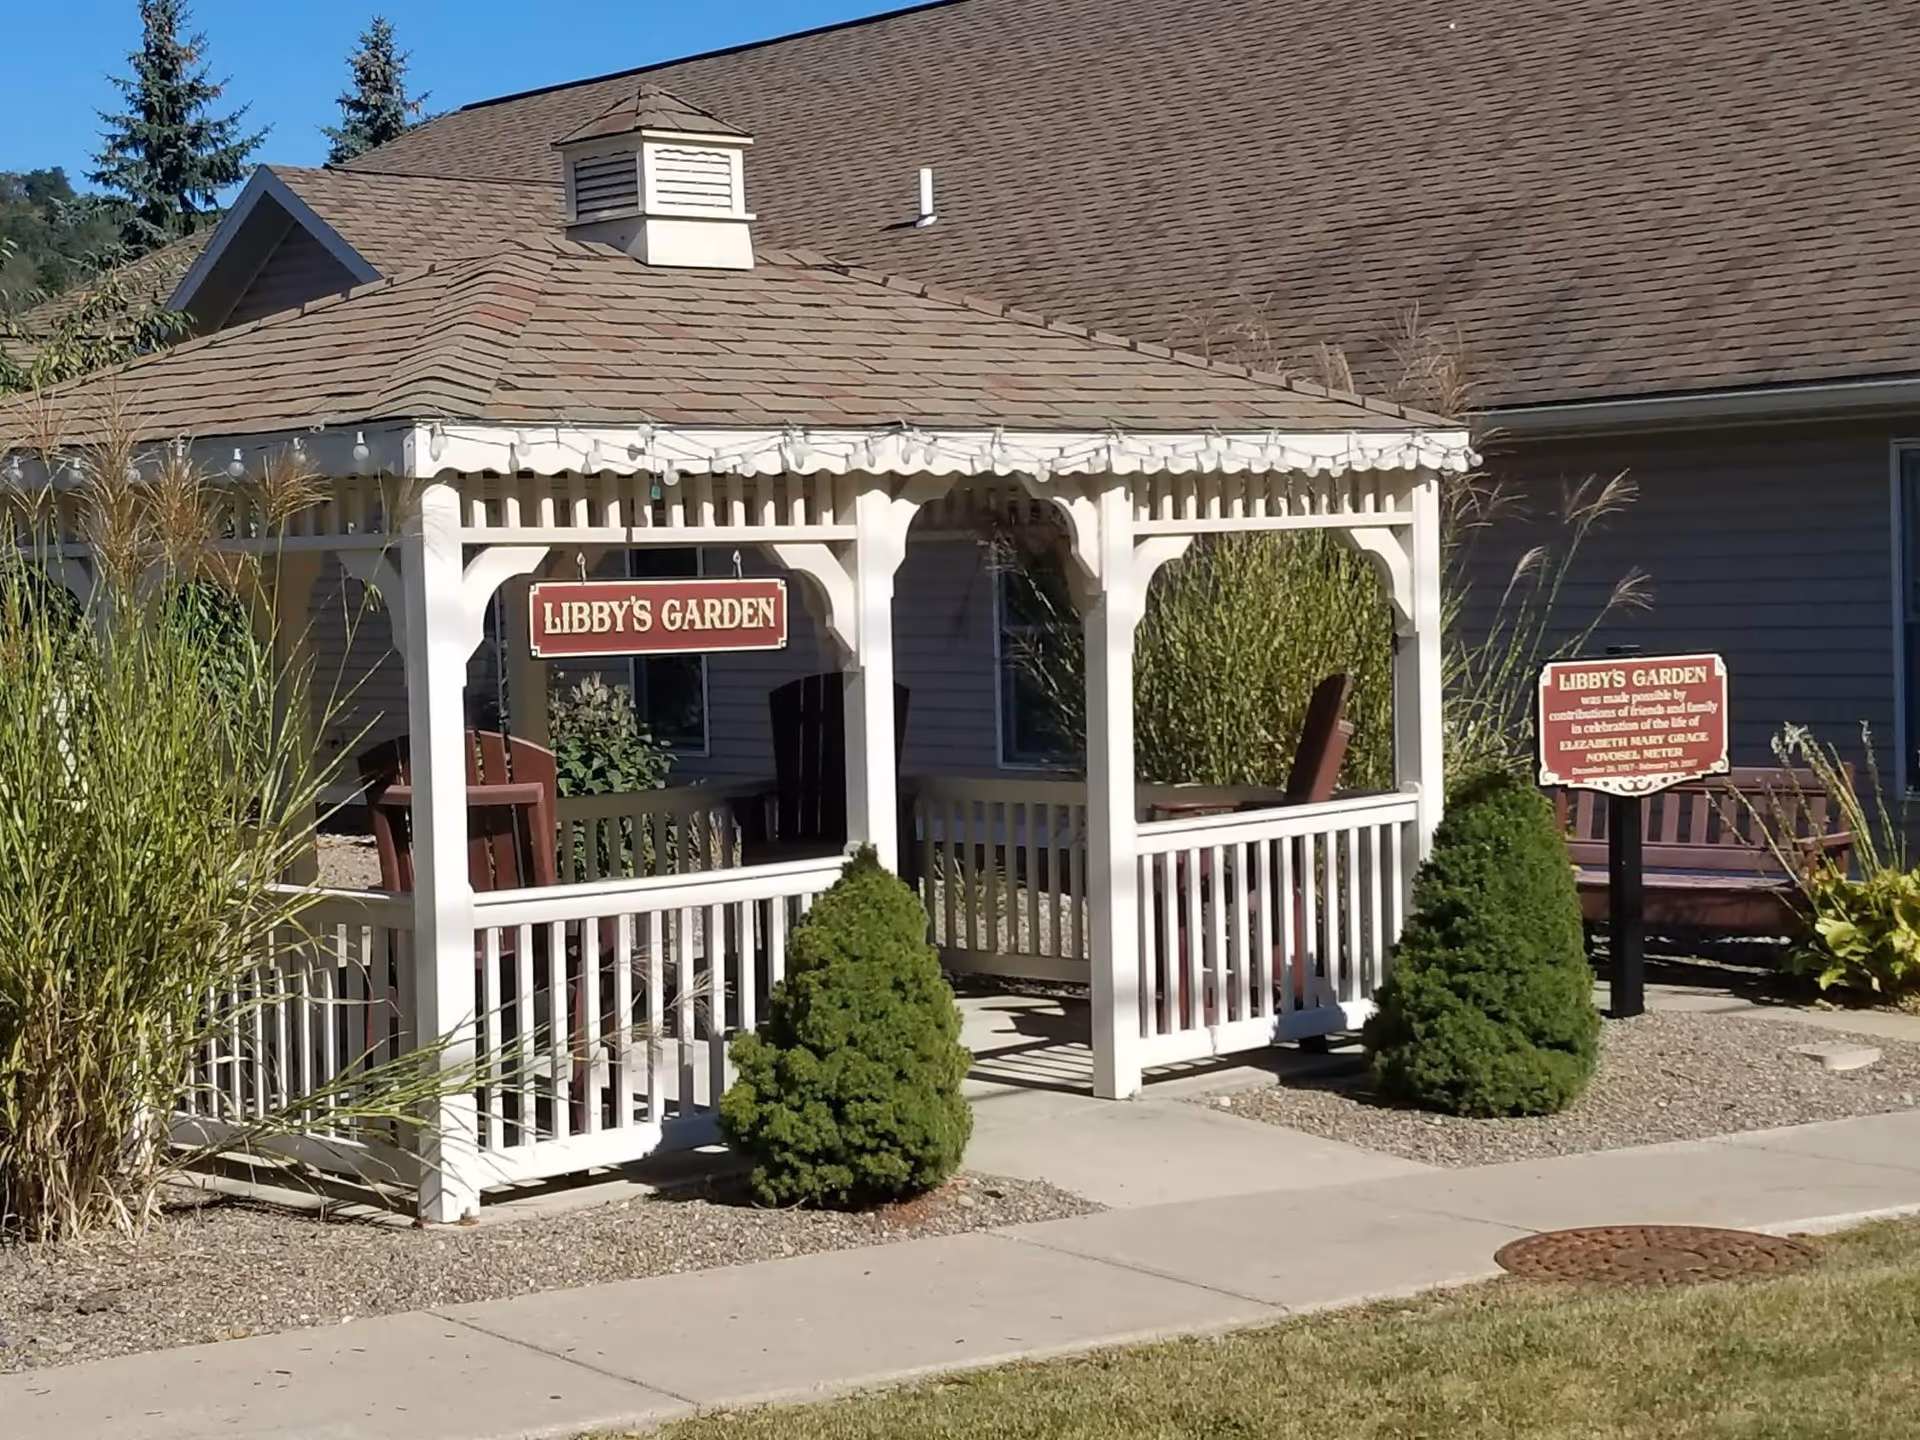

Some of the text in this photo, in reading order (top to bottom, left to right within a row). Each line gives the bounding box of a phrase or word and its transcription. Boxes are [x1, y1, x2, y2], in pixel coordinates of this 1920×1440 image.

[543, 595, 776, 635] LIBBY'S GARDEN
[1559, 666, 1707, 691] LIBBY'S GARDEN
[1580, 689, 1687, 705] was made possible by
[1549, 701, 1718, 721] contributions of friends and family
[1571, 716, 1700, 734] in celebration of the life of
[1559, 732, 1709, 751] ELIZABETH MARY GRACE
[1586, 750, 1641, 763] NOVOSEL
